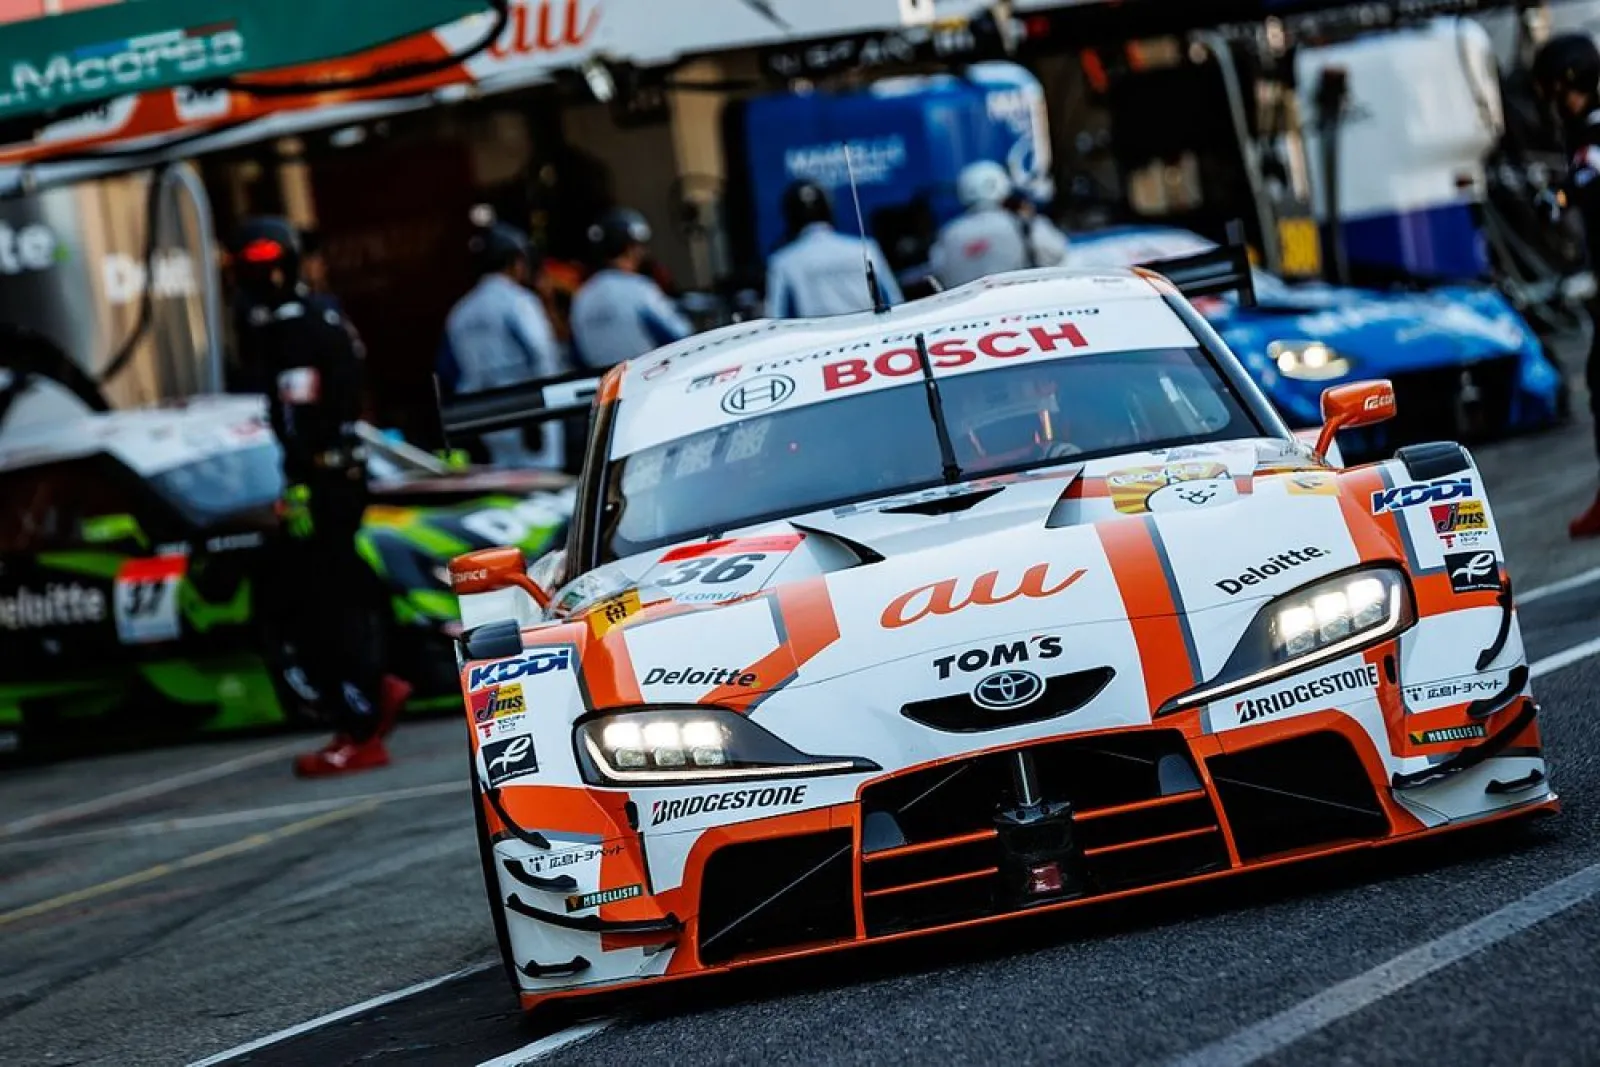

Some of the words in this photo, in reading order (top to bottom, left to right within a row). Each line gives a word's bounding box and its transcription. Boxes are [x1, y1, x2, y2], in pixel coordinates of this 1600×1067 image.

[822, 322, 1089, 392] BOSCH
[1372, 478, 1473, 513] KDDI
[655, 553, 767, 587] 36
[880, 562, 1088, 629] au
[470, 649, 569, 691] KDDI
[1235, 665, 1379, 724] BRIDGESTONE
[651, 784, 808, 827] BRIDGESTONE
